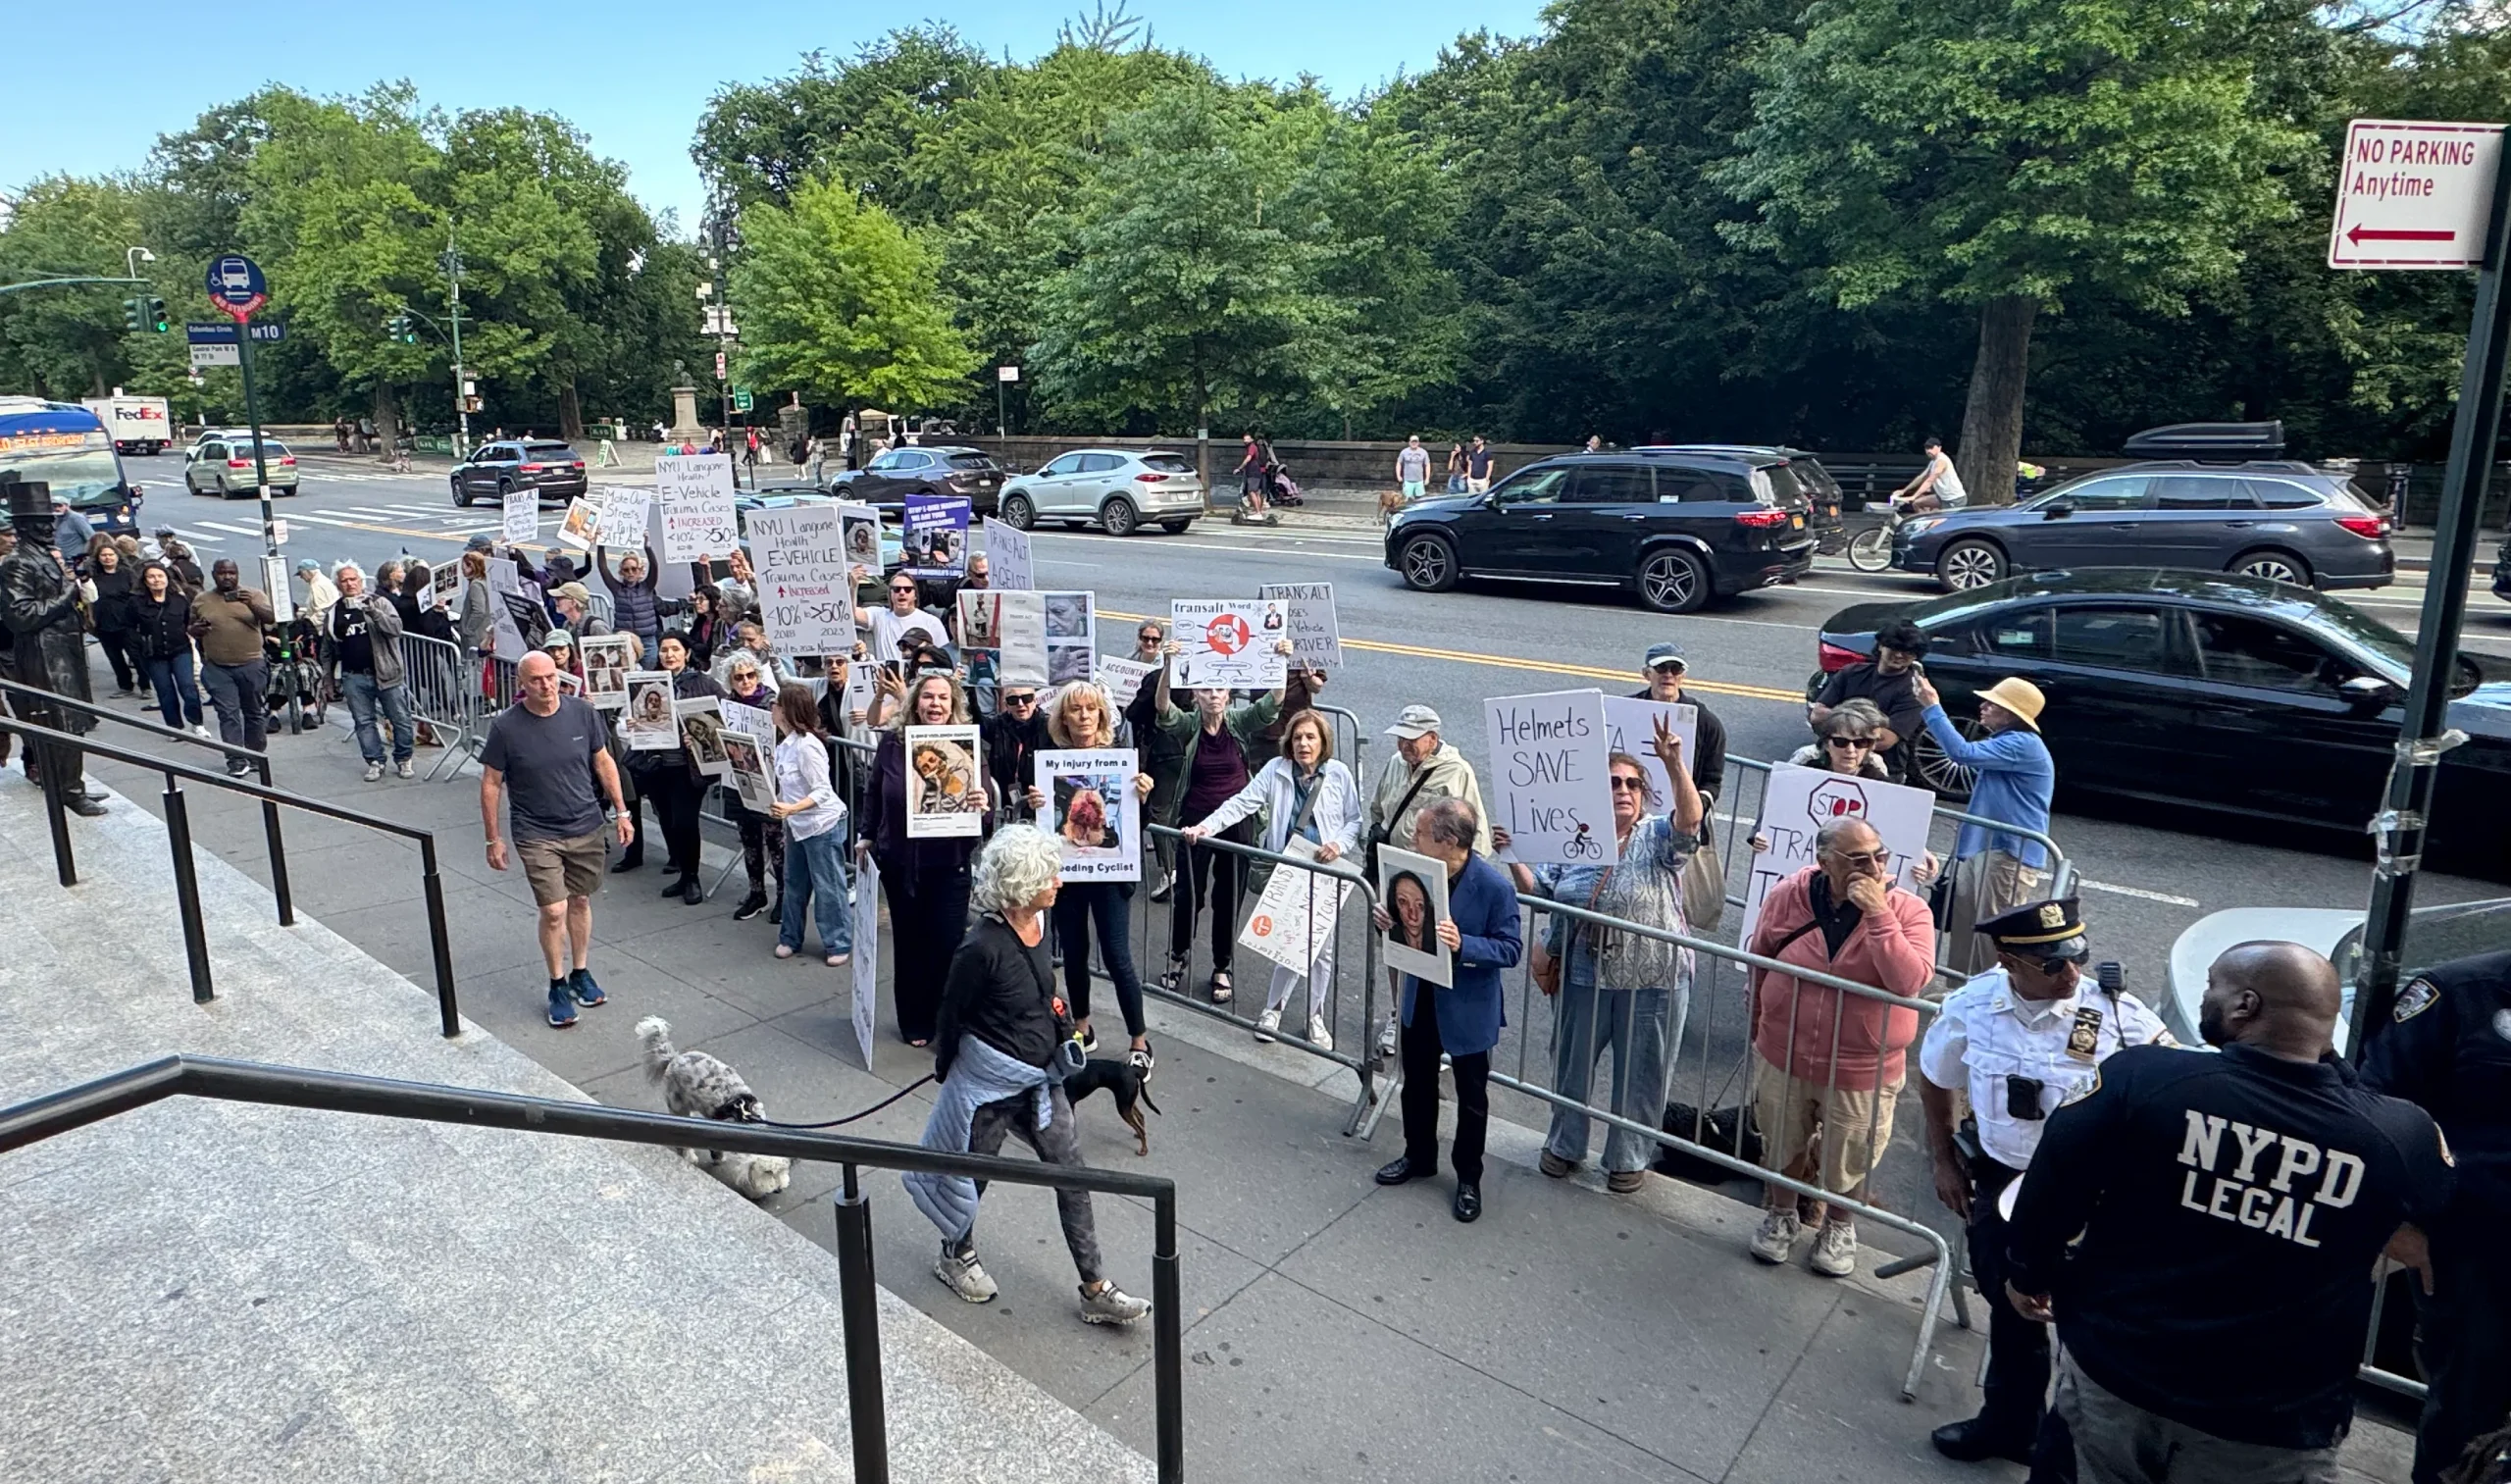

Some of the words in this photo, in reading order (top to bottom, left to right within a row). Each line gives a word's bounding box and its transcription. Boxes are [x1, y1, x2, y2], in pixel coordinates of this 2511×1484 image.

[2357, 138, 2384, 163] NO
[2389, 139, 2475, 165] PARKING
[2352, 171, 2434, 201] Anytime
[251, 326, 280, 339] M10
[116, 408, 164, 420] FedEx
[659, 462, 681, 473] NYU
[661, 485, 722, 501] E-Vehicle
[678, 516, 723, 527] INCREASED
[753, 518, 783, 536] NYU
[791, 518, 834, 539] Langone
[775, 537, 808, 549] Health
[767, 547, 838, 567] E-VEHICLE
[761, 569, 804, 585] Trauma
[810, 567, 845, 583] Cases
[1267, 586, 1308, 600] TRANS
[1310, 586, 1330, 600] ALT
[766, 604, 802, 626] <10%
[810, 600, 850, 624] >50%
[1175, 602, 1224, 614] transalt
[345, 622, 367, 636] NY
[1293, 636, 1334, 652] RIVER
[726, 702, 772, 730] E-Vehicles
[1496, 706, 1589, 745] Helmets
[1046, 759, 1059, 770] My
[1509, 749, 1584, 787] SAVE
[1510, 791, 1581, 835] Lives
[1814, 793, 1862, 816] STOP
[1097, 863, 1134, 873] Cyclist
[2177, 1108, 2366, 1208] NYPD
[2181, 1169, 2321, 1248] LEGAL
